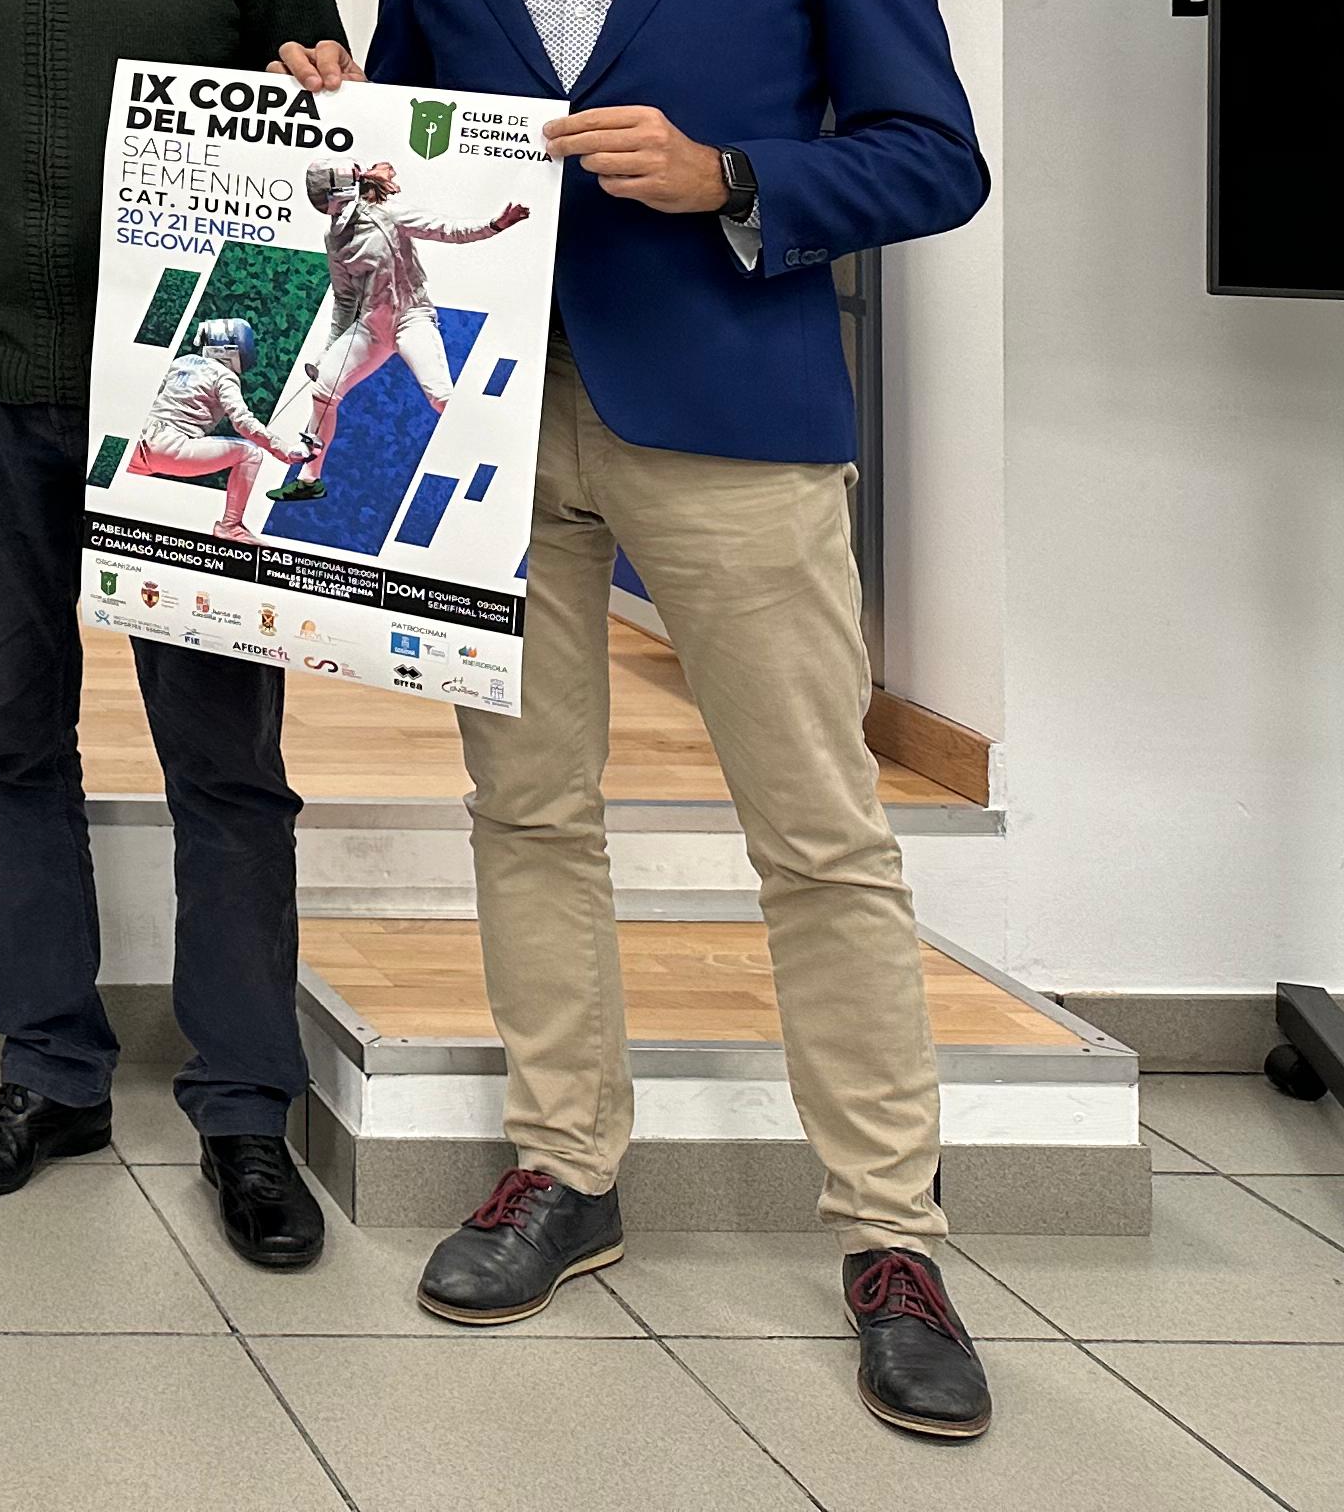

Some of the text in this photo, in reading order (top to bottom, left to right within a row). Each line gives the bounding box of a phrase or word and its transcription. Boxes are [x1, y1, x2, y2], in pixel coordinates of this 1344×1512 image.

[130, 73, 320, 120] IX COPA
[126, 106, 353, 152] DEL MUNDO
[463, 112, 529, 127] CLUB DE
[461, 128, 530, 143] ESGRIMA
[122, 136, 221, 167] SABLE
[460, 144, 552, 163] DE SEGOVIA
[122, 161, 293, 201] FEMENINO
[119, 188, 291, 222] CAT. JUNIOR
[117, 208, 275, 242] 20 Y 21 ENERO
[117, 228, 215, 256] SEGOVIA
[92, 522, 252, 561] PABELLÓN: PEDRO DELGADO
[91, 536, 224, 570] C/ DAMASÓ ALONSO S/N
[262, 550, 293, 565] SAB
[295, 557, 346, 574] INDIVIDUAL
[296, 566, 346, 584] SEMIFINAL
[387, 582, 425, 600] DOM
[428, 591, 471, 605] EQUIPOS
[428, 601, 508, 623] SEMIFINAL 14:00H
[232, 641, 290, 661] AFEDECYL
